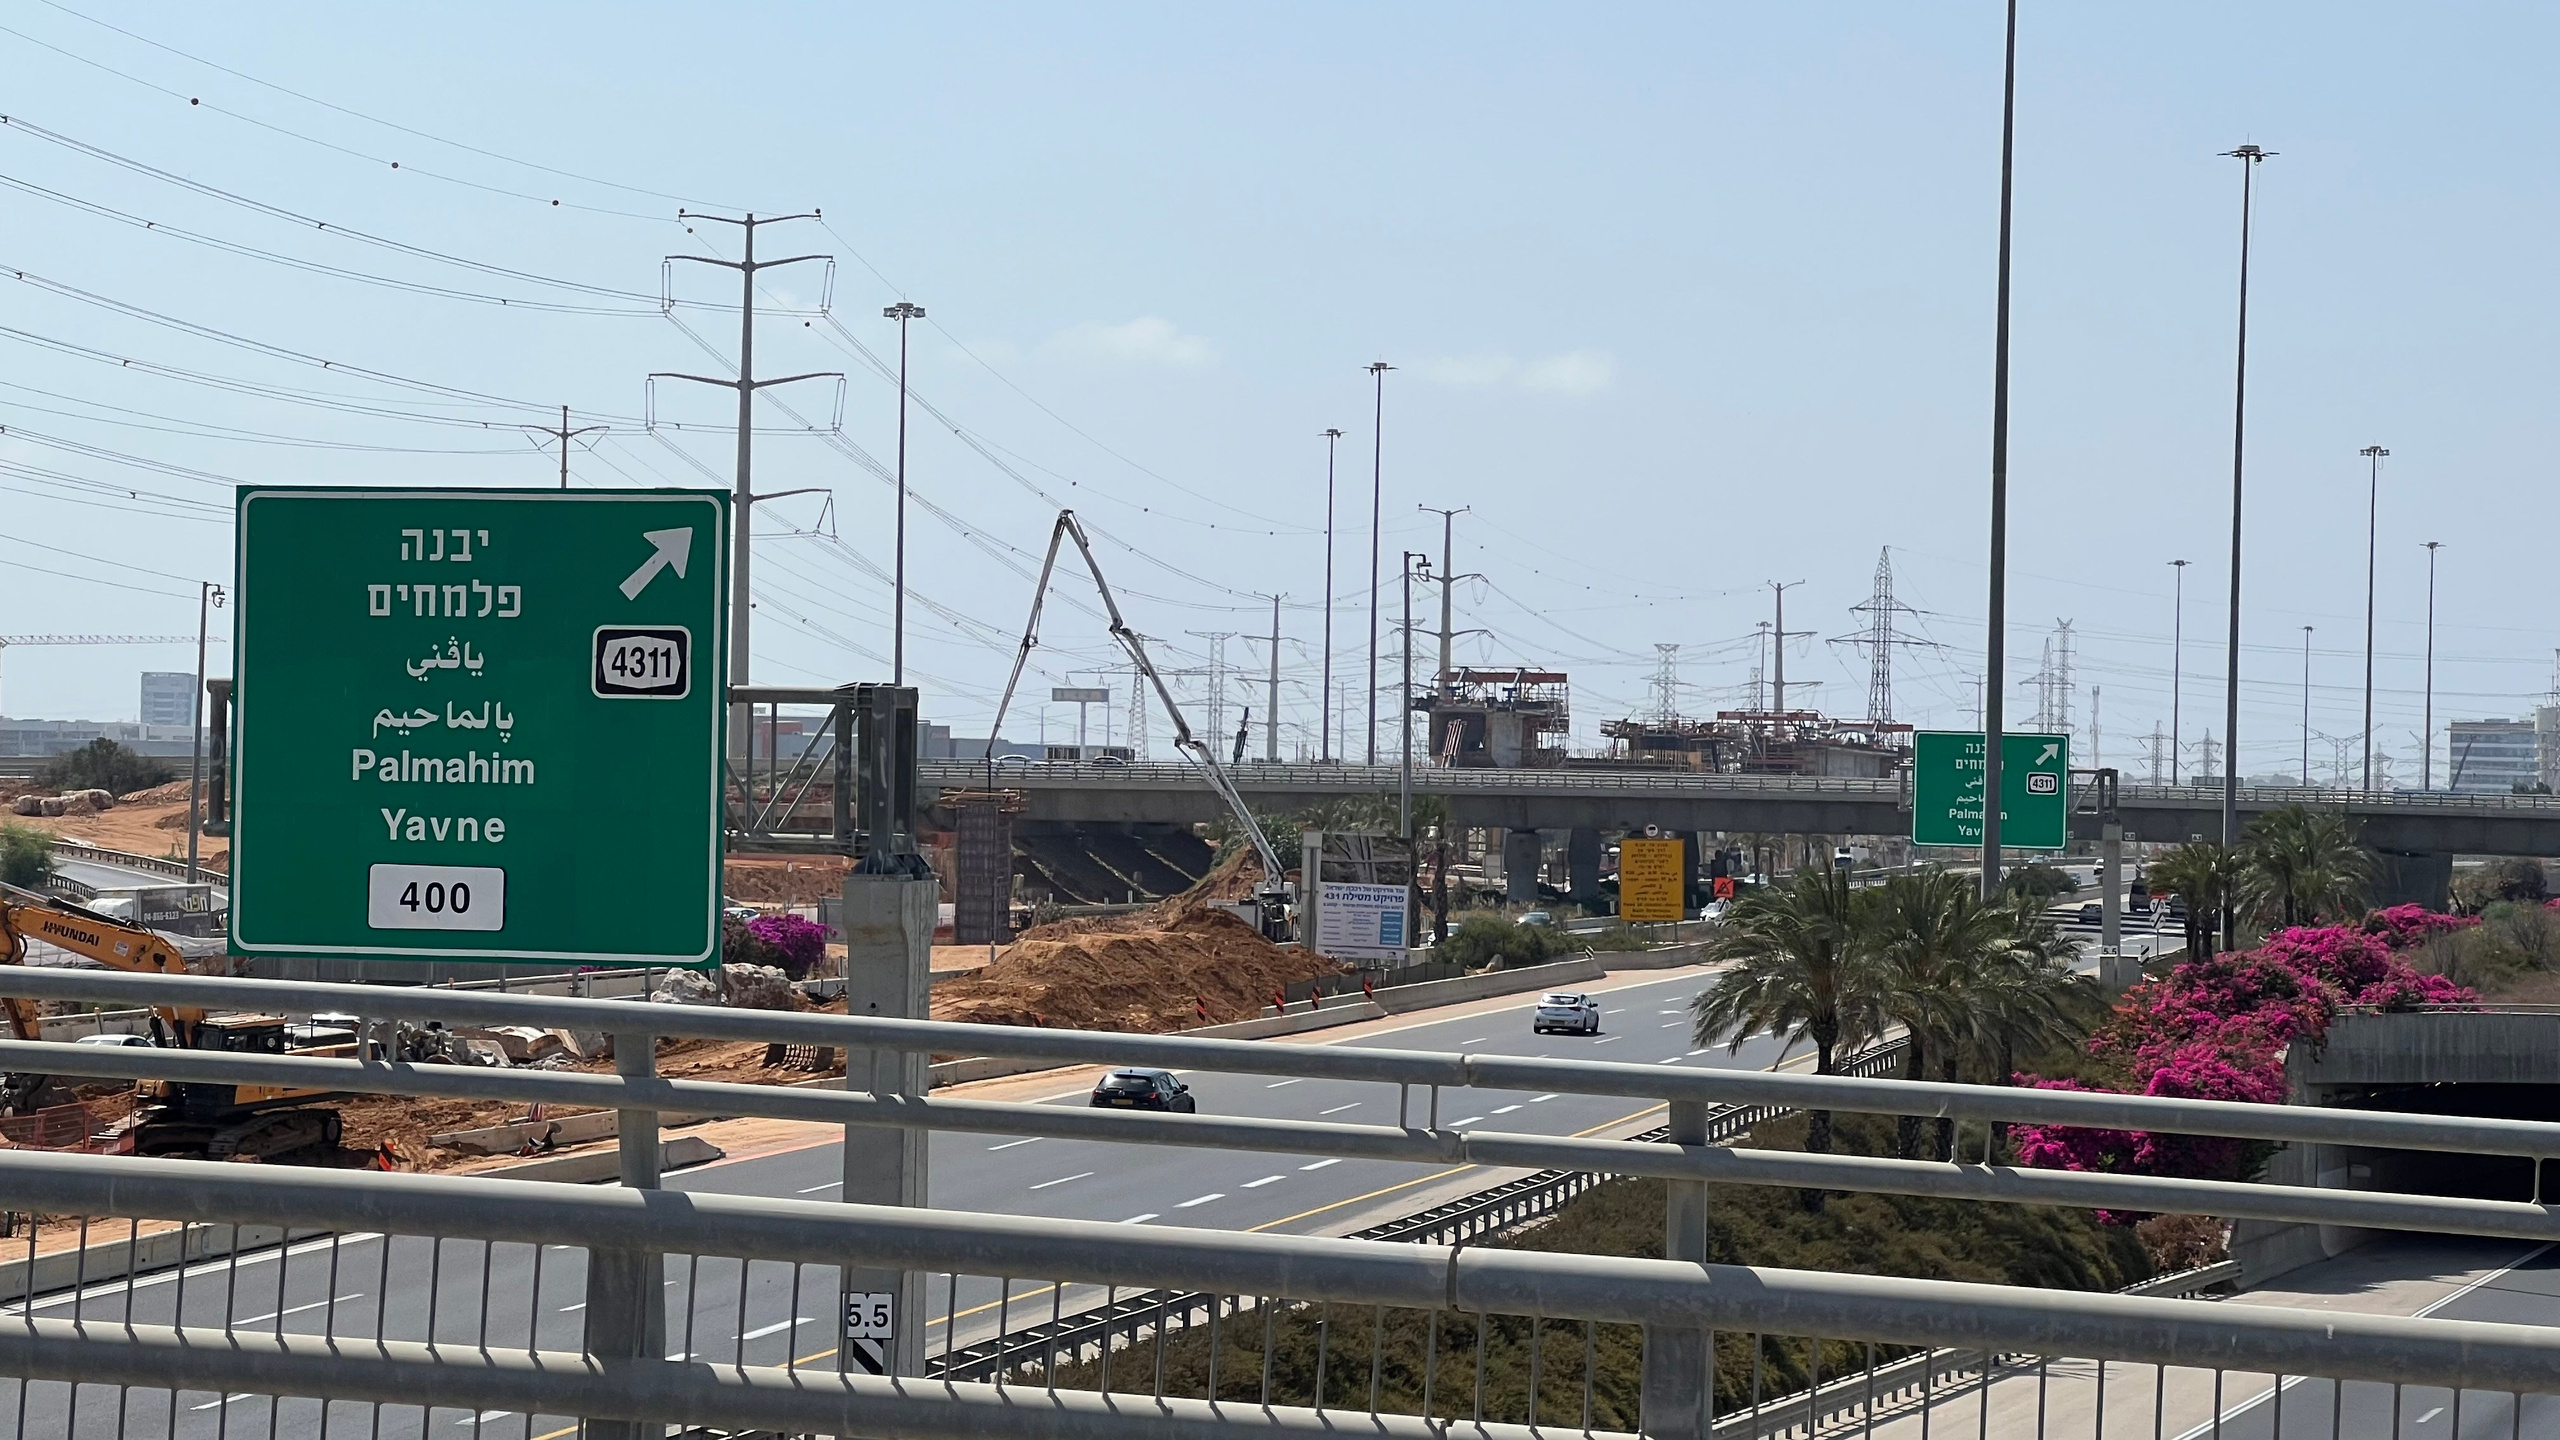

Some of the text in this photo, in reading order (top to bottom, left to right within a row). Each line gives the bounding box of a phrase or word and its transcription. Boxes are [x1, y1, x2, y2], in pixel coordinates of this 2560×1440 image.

[402, 529, 489, 561] יבנה
[368, 579, 521, 617] פלמחים
[611, 646, 672, 678] 4311
[353, 749, 535, 784] Palmahim
[2032, 778, 2053, 789] 4311
[381, 808, 505, 843] Yavne
[399, 881, 471, 914] 400
[1324, 891, 1405, 904] פרויקט מסילת 431
[43, 920, 100, 947] HYUNDAI
[847, 1303, 889, 1328] 5.5
